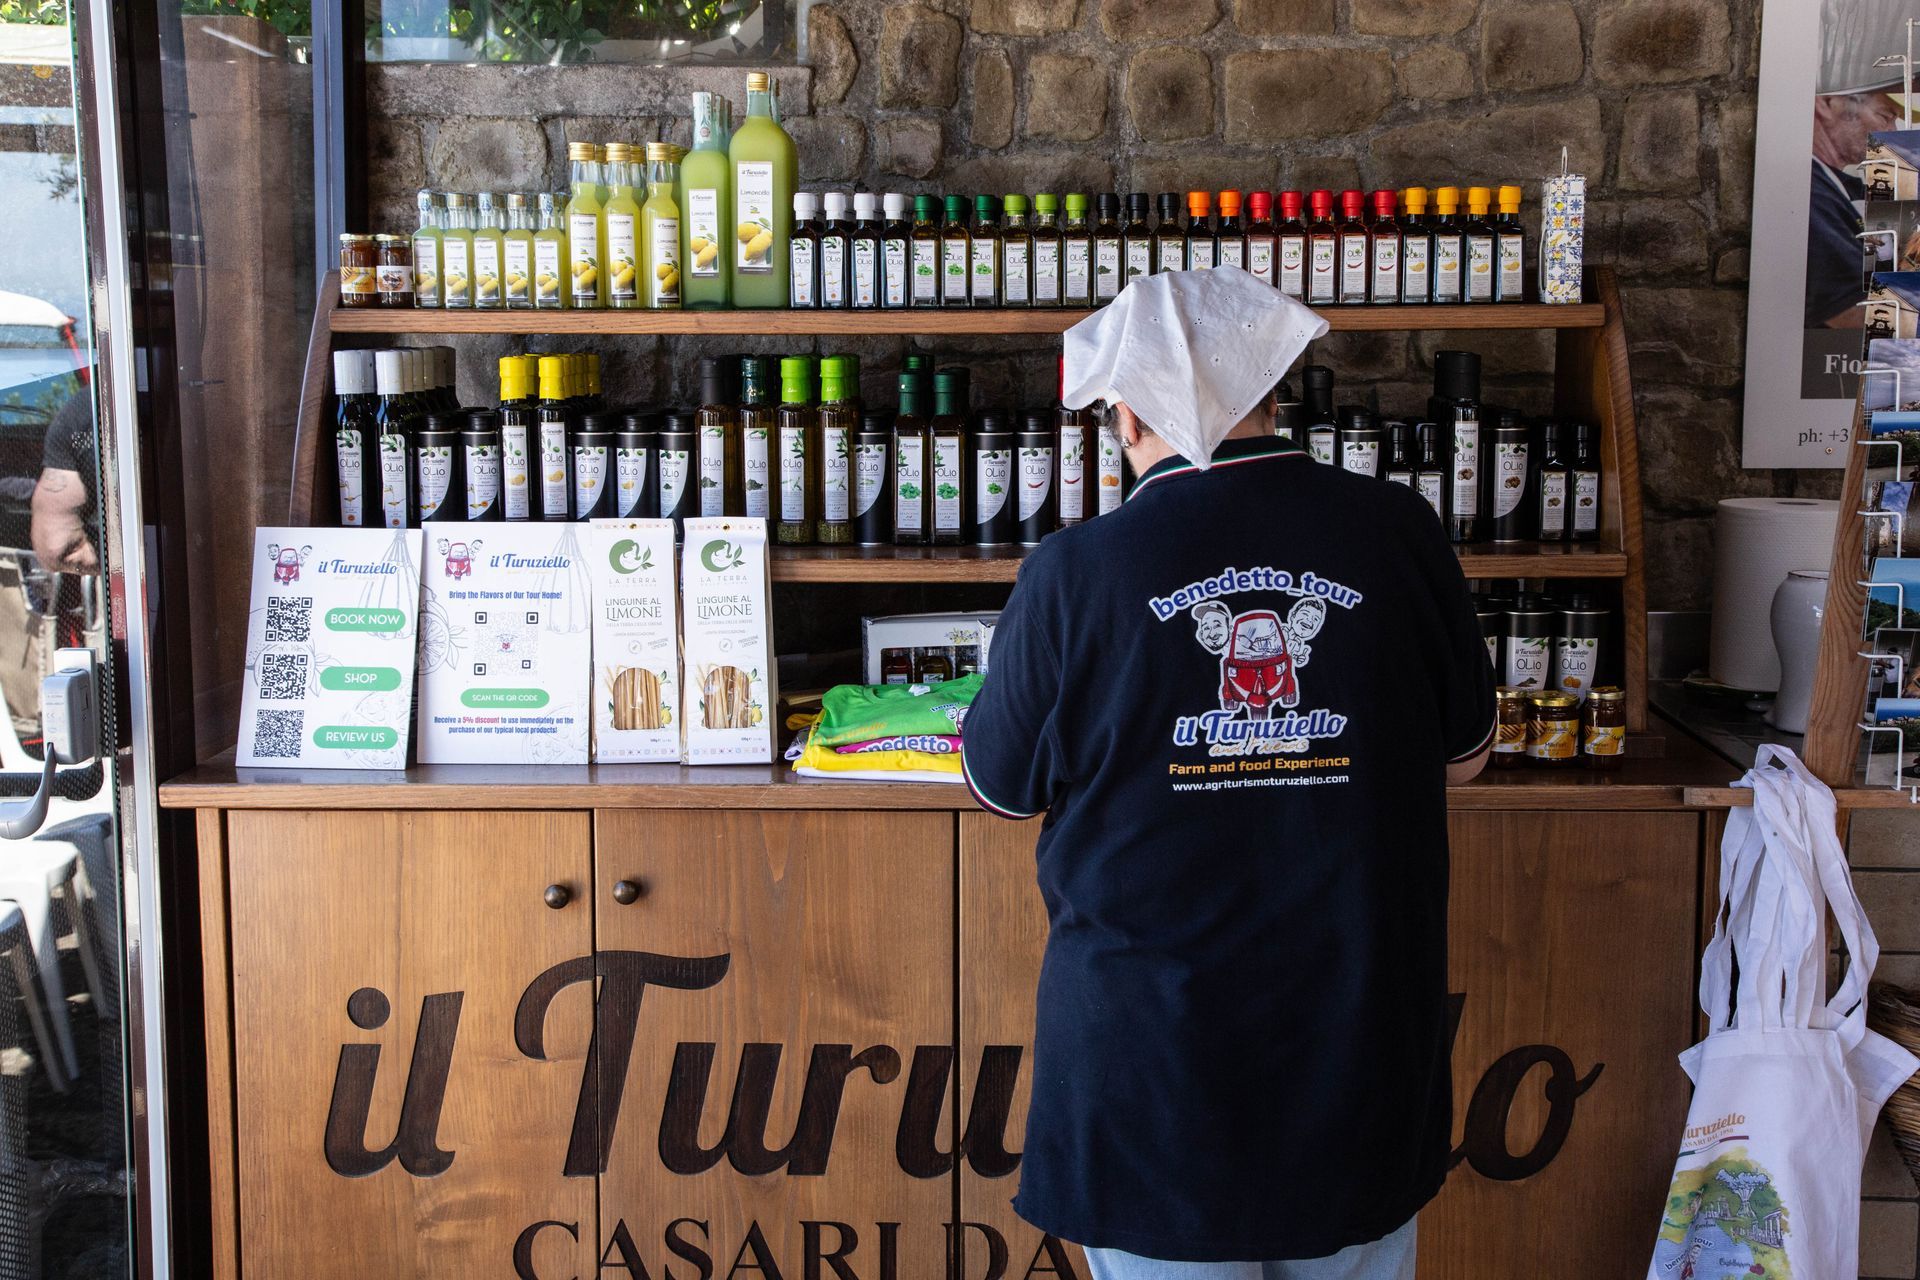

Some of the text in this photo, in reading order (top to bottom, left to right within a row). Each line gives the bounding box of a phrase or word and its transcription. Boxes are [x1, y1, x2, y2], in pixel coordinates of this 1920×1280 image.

[1798, 428, 1823, 446] ph:
[318, 559, 399, 574] il Turuziello
[490, 553, 571, 568] il Turuziello
[449, 591, 562, 600] Bring the Flavors of Our Tour Home!
[605, 597, 662, 606] LINGUINE AL
[696, 595, 752, 604] LINGUINE AL
[1150, 567, 1362, 621] benedetto_tour
[606, 606, 662, 622] LIMONE
[697, 603, 753, 619] LIMONE
[330, 613, 400, 625] BOOK NOW
[344, 672, 378, 684] SHOP
[472, 694, 491, 702] SCAN
[492, 694, 504, 702] THE
[518, 694, 538, 702] CODE
[475, 716, 500, 724] discount
[1175, 709, 1348, 745] il Turuziello
[326, 731, 385, 743] REVIEW US
[1168, 756, 1351, 776] Farm and food Experience
[1172, 774, 1350, 792] www.agriturismoturuziello.com
[323, 986, 465, 1178] il
[1684, 1138, 1706, 1148] ASARI
[512, 1217, 902, 1280] CASARI
